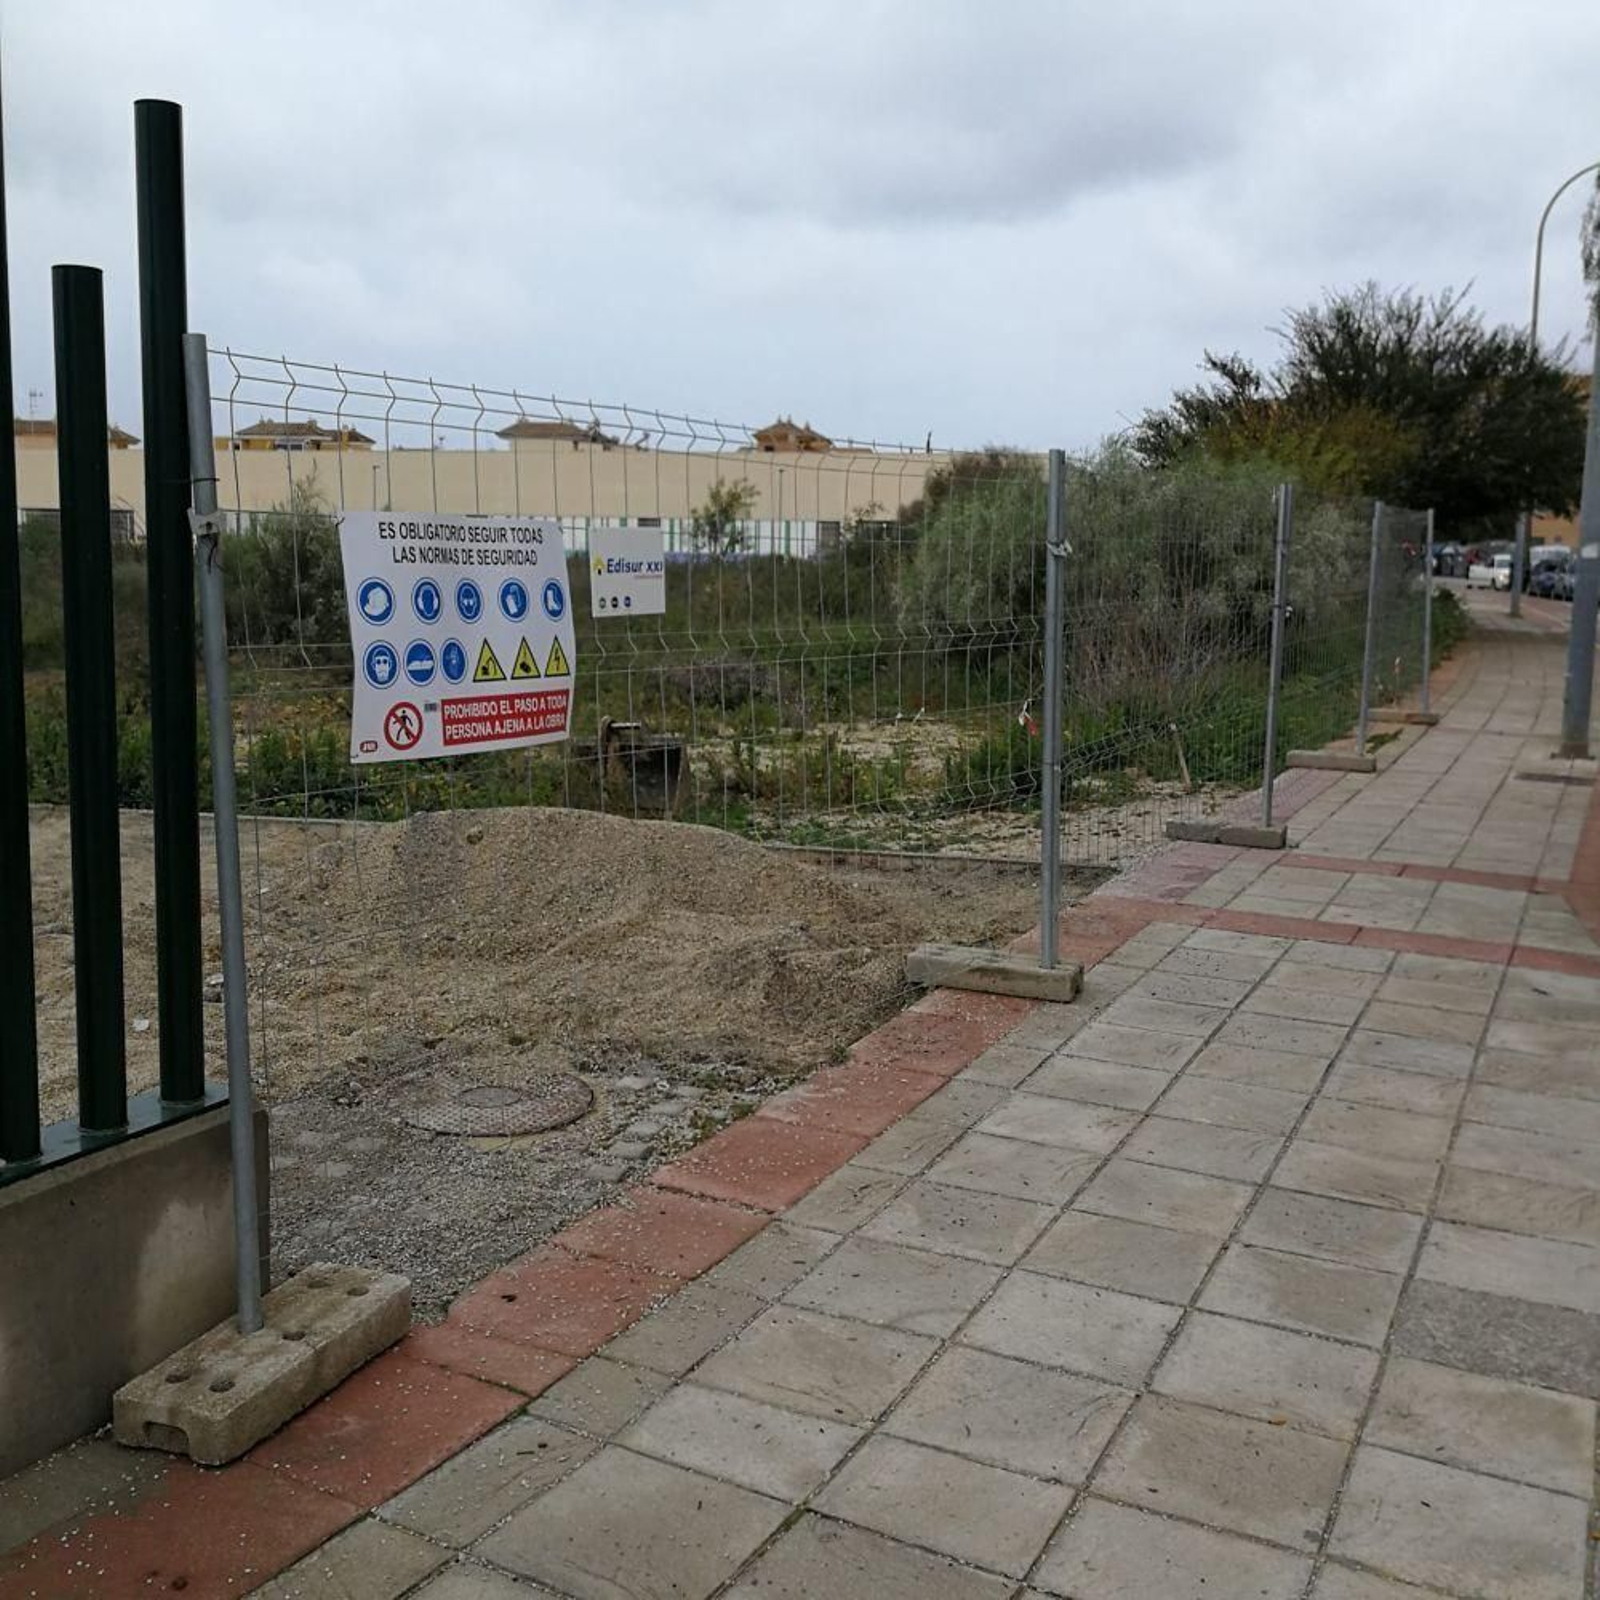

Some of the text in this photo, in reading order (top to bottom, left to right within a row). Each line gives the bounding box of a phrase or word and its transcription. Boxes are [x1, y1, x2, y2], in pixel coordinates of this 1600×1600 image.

[379, 522, 543, 544] ES OBLIGATORIO SEGUIR TODAS
[393, 546, 538, 565] LAS NORMAS DE SEGURIDAD
[607, 558, 643, 574] Edisur
[443, 701, 498, 720] PROHIBIDO
[500, 700, 513, 714] EL
[514, 697, 538, 713] PASO
[540, 697, 546, 710] A
[547, 695, 567, 709] TODA
[445, 713, 565, 740] PERSONA AJENA A LA OBRA
